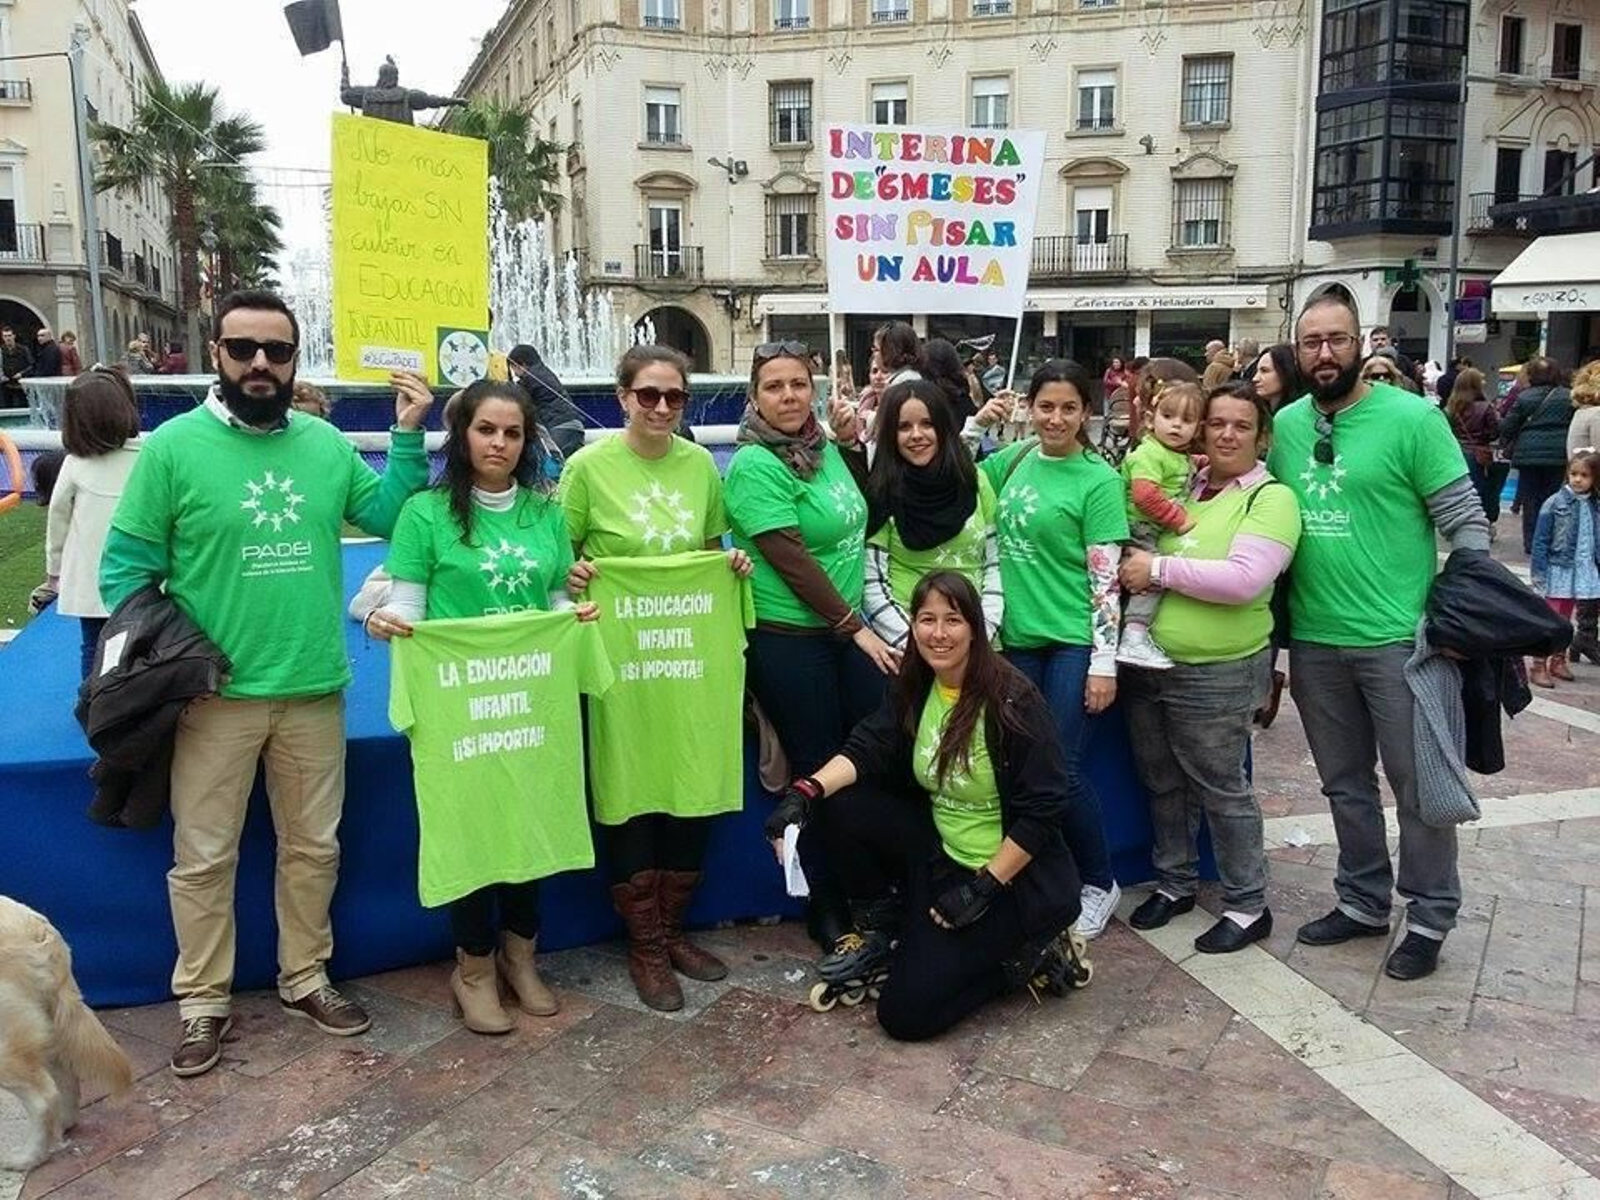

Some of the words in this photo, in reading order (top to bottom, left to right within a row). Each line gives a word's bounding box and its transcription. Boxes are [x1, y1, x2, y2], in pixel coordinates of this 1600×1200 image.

[350, 125, 391, 166] No
[829, 128, 1021, 166] INTERINA
[424, 191, 464, 226] SIN
[835, 214, 899, 243] SIN
[906, 209, 1017, 247] PISAR
[359, 262, 475, 309] EDUCACIÓN
[857, 253, 904, 282] UN
[912, 254, 1006, 287] AULA
[1137, 298, 1148, 307] &
[242, 540, 312, 560] PADEI
[614, 596, 634, 619] LA
[636, 588, 713, 618] EDUCACIÓN
[637, 627, 694, 651] INFANTIL
[438, 662, 461, 688] LA
[466, 648, 552, 684] EDUCACIÓN
[467, 691, 532, 721] INFANTIL
